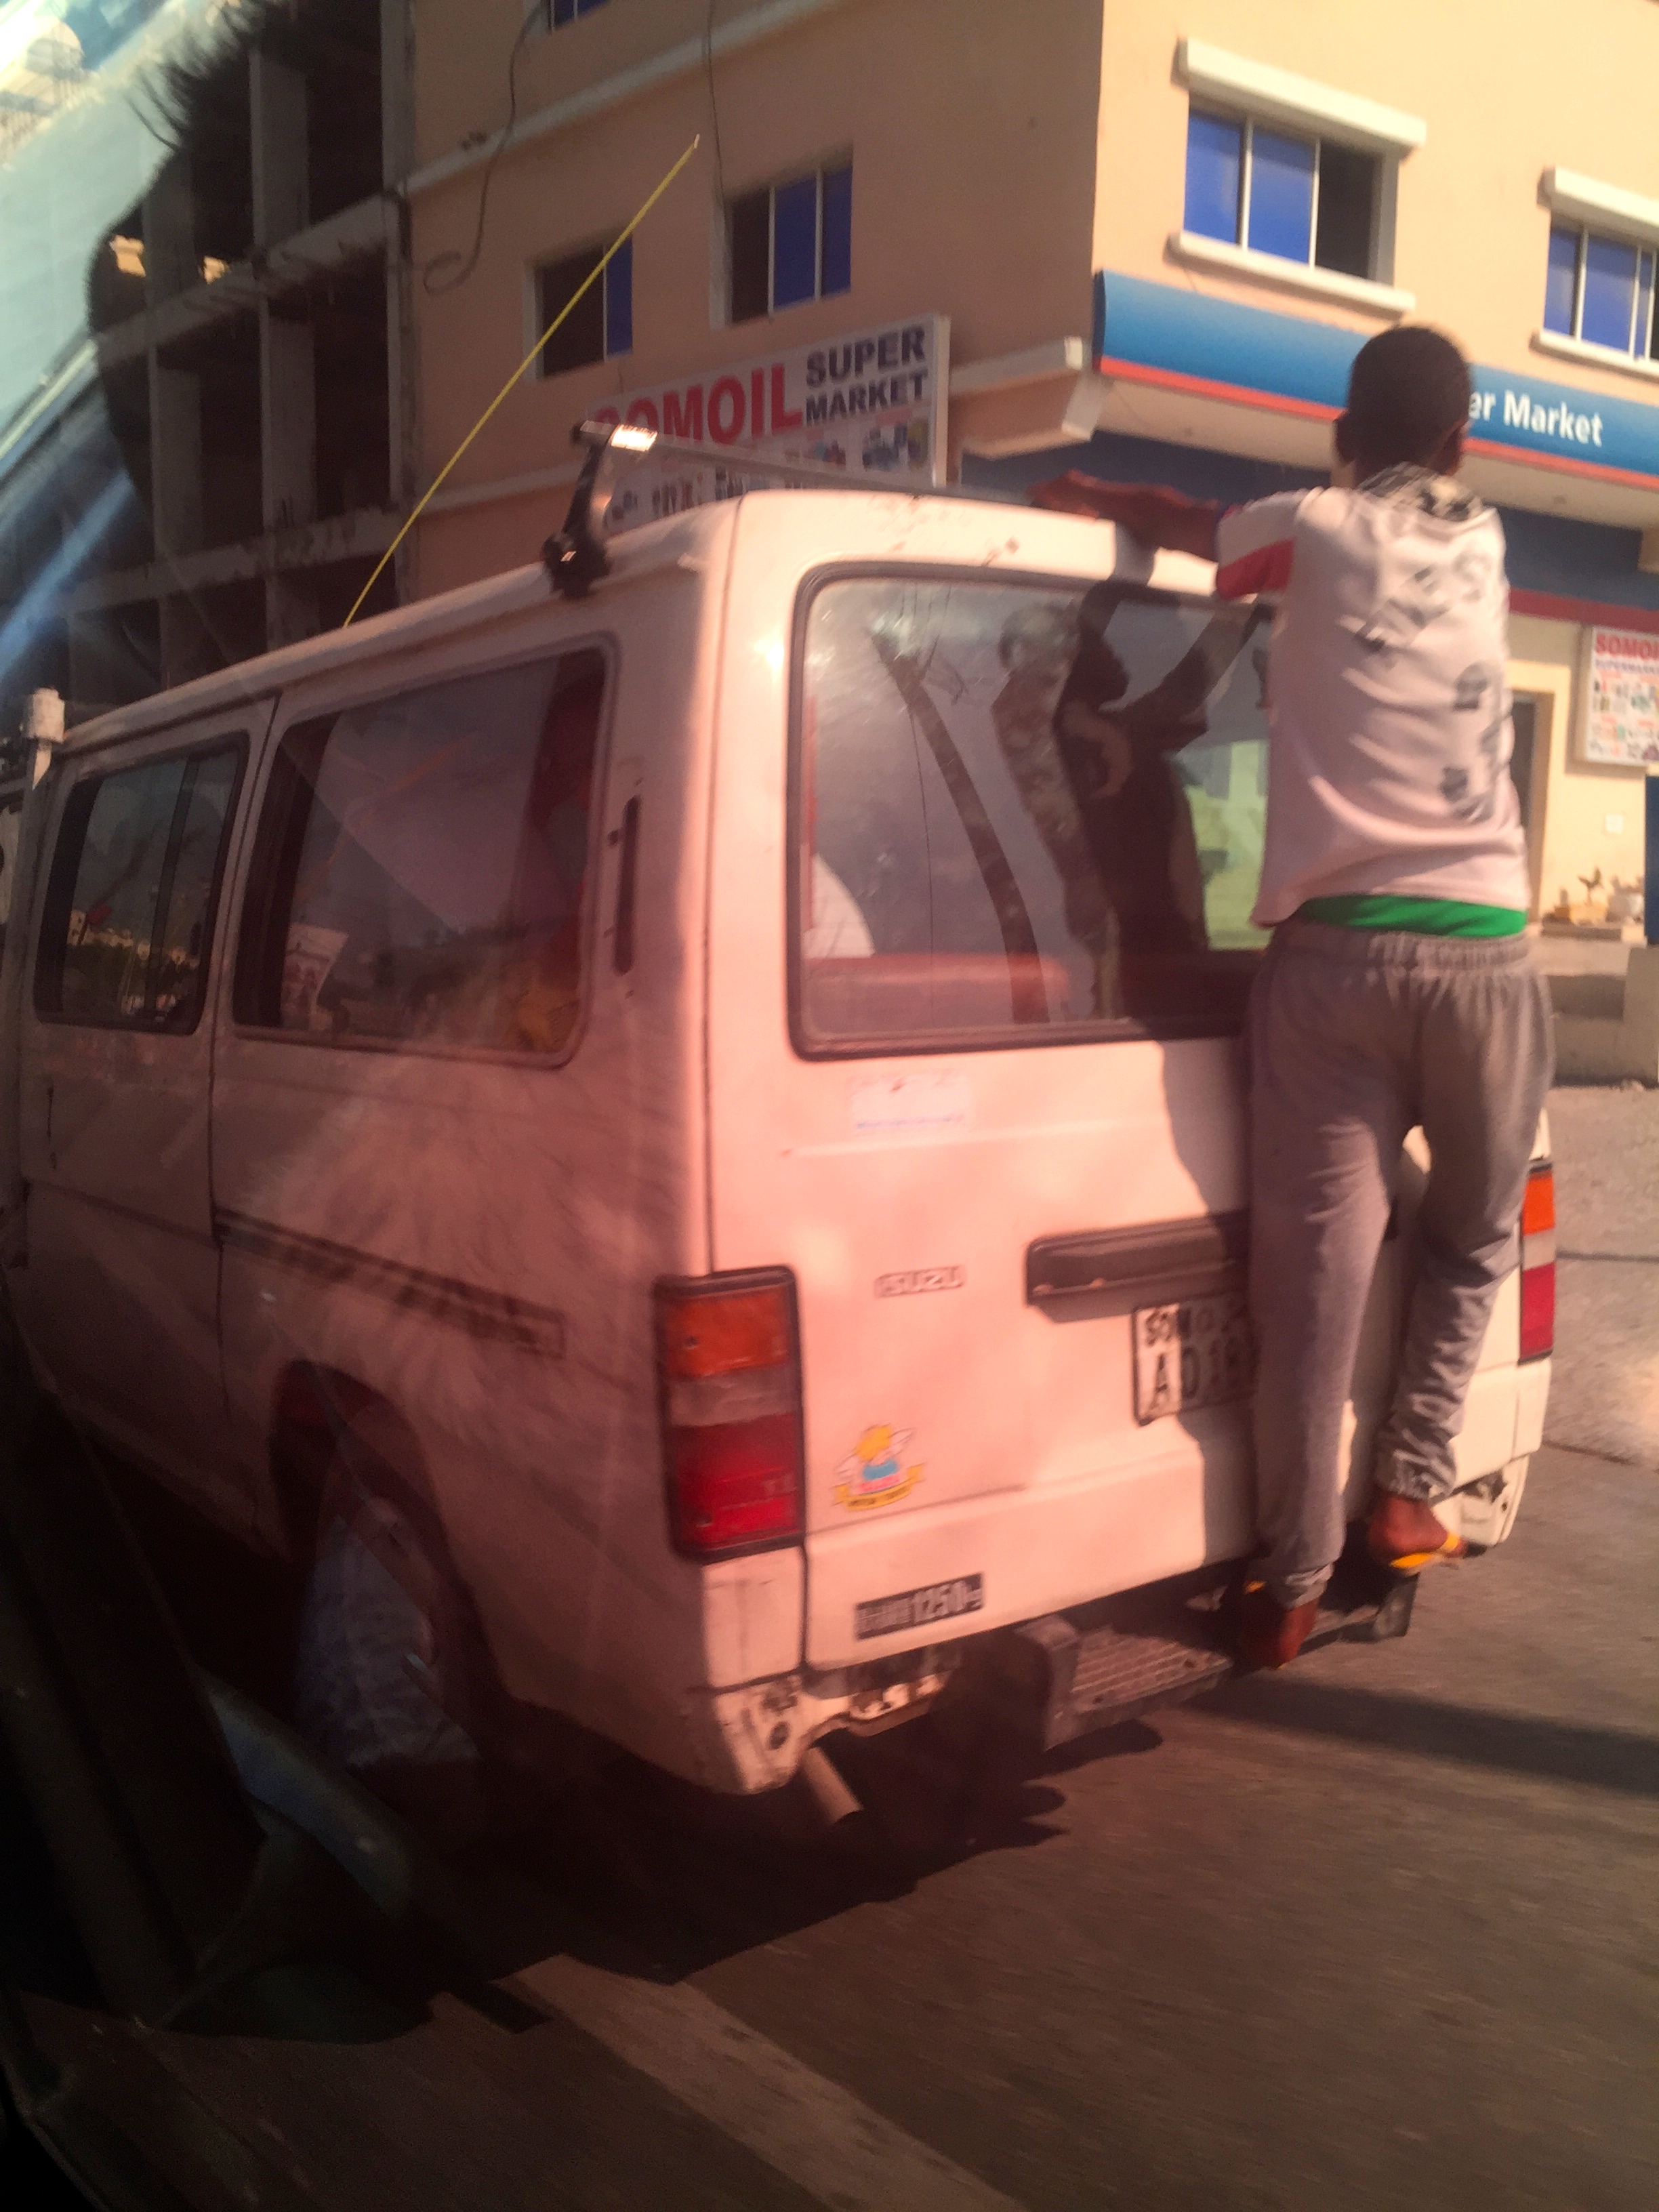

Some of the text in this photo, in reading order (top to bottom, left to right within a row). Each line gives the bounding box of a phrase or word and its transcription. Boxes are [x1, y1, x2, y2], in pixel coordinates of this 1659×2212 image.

[806, 325, 926, 388] SUPER
[806, 369, 929, 426] MARKET
[1502, 389, 1603, 448] Market
